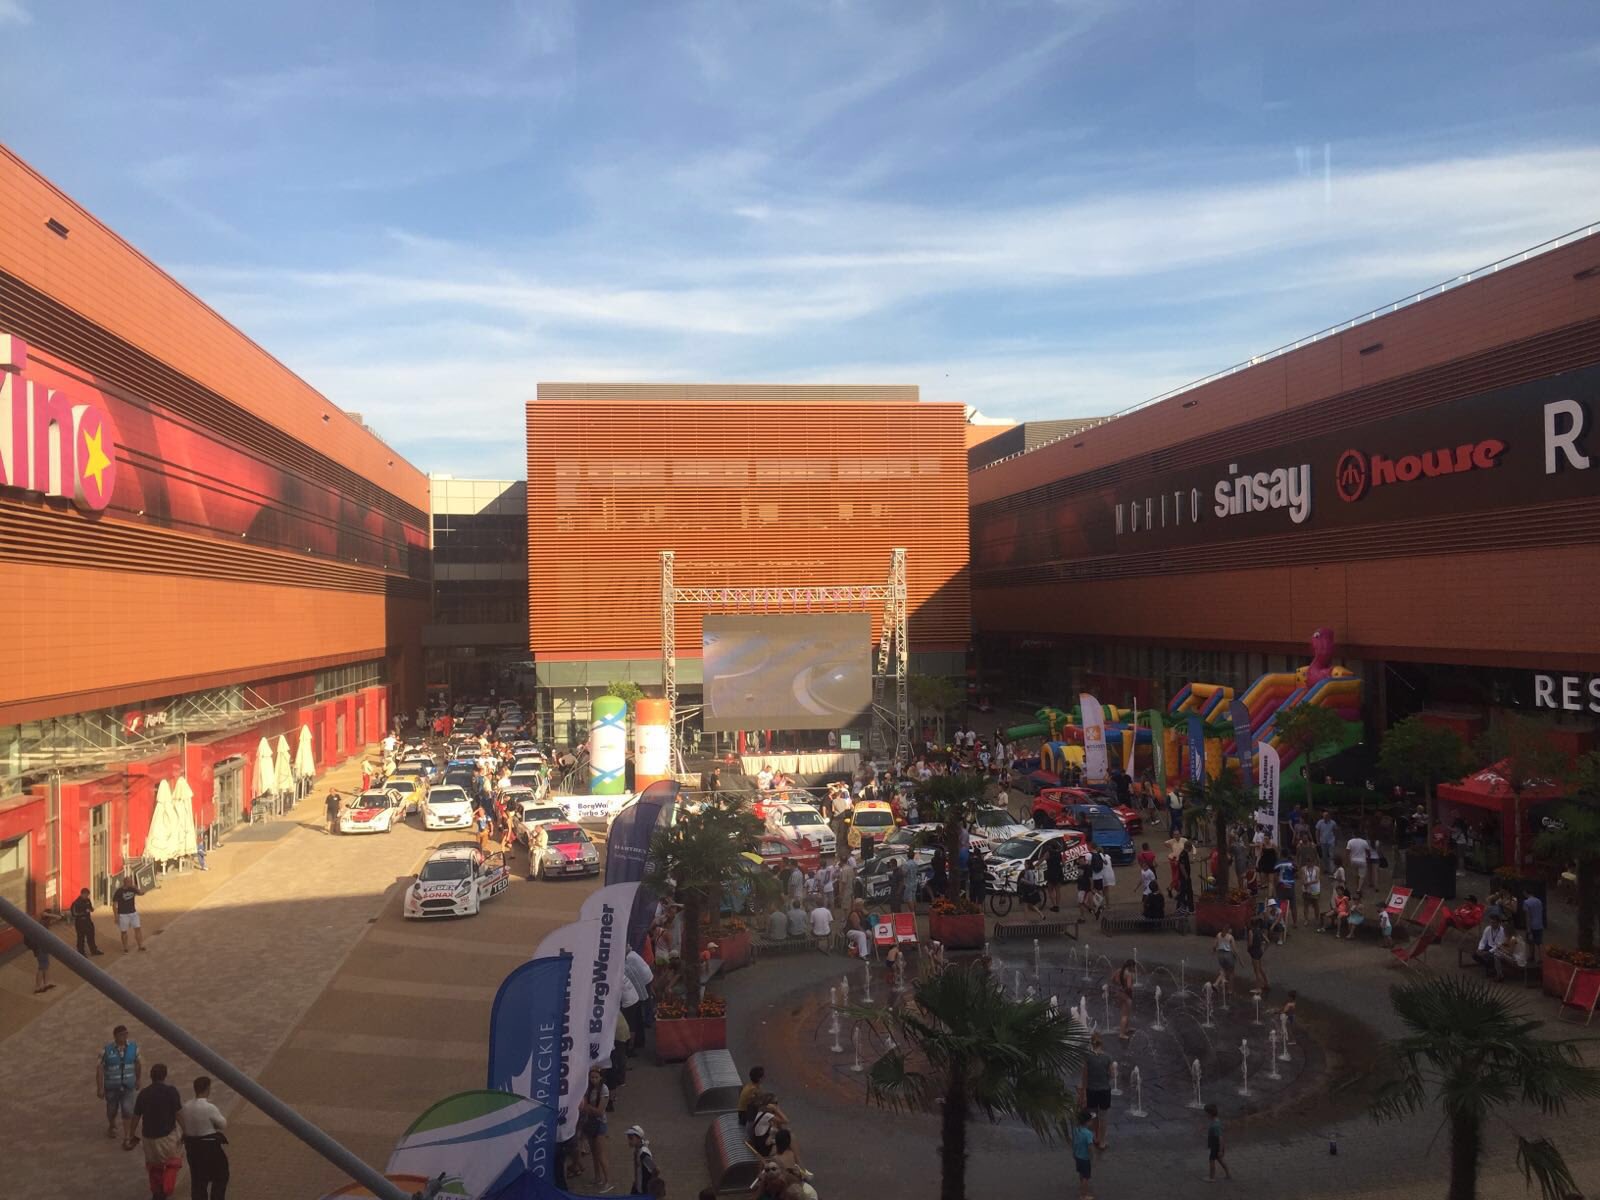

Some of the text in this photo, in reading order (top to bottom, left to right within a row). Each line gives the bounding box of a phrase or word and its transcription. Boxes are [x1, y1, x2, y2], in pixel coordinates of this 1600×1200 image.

[0, 333, 117, 510] ino
[1543, 399, 1590, 475] R
[1371, 439, 1506, 486] house
[1114, 487, 1199, 536] MOHITO
[1214, 463, 1312, 524] sinsay
[492, 878, 508, 893] TED
[589, 903, 614, 1033] BorgWarner
